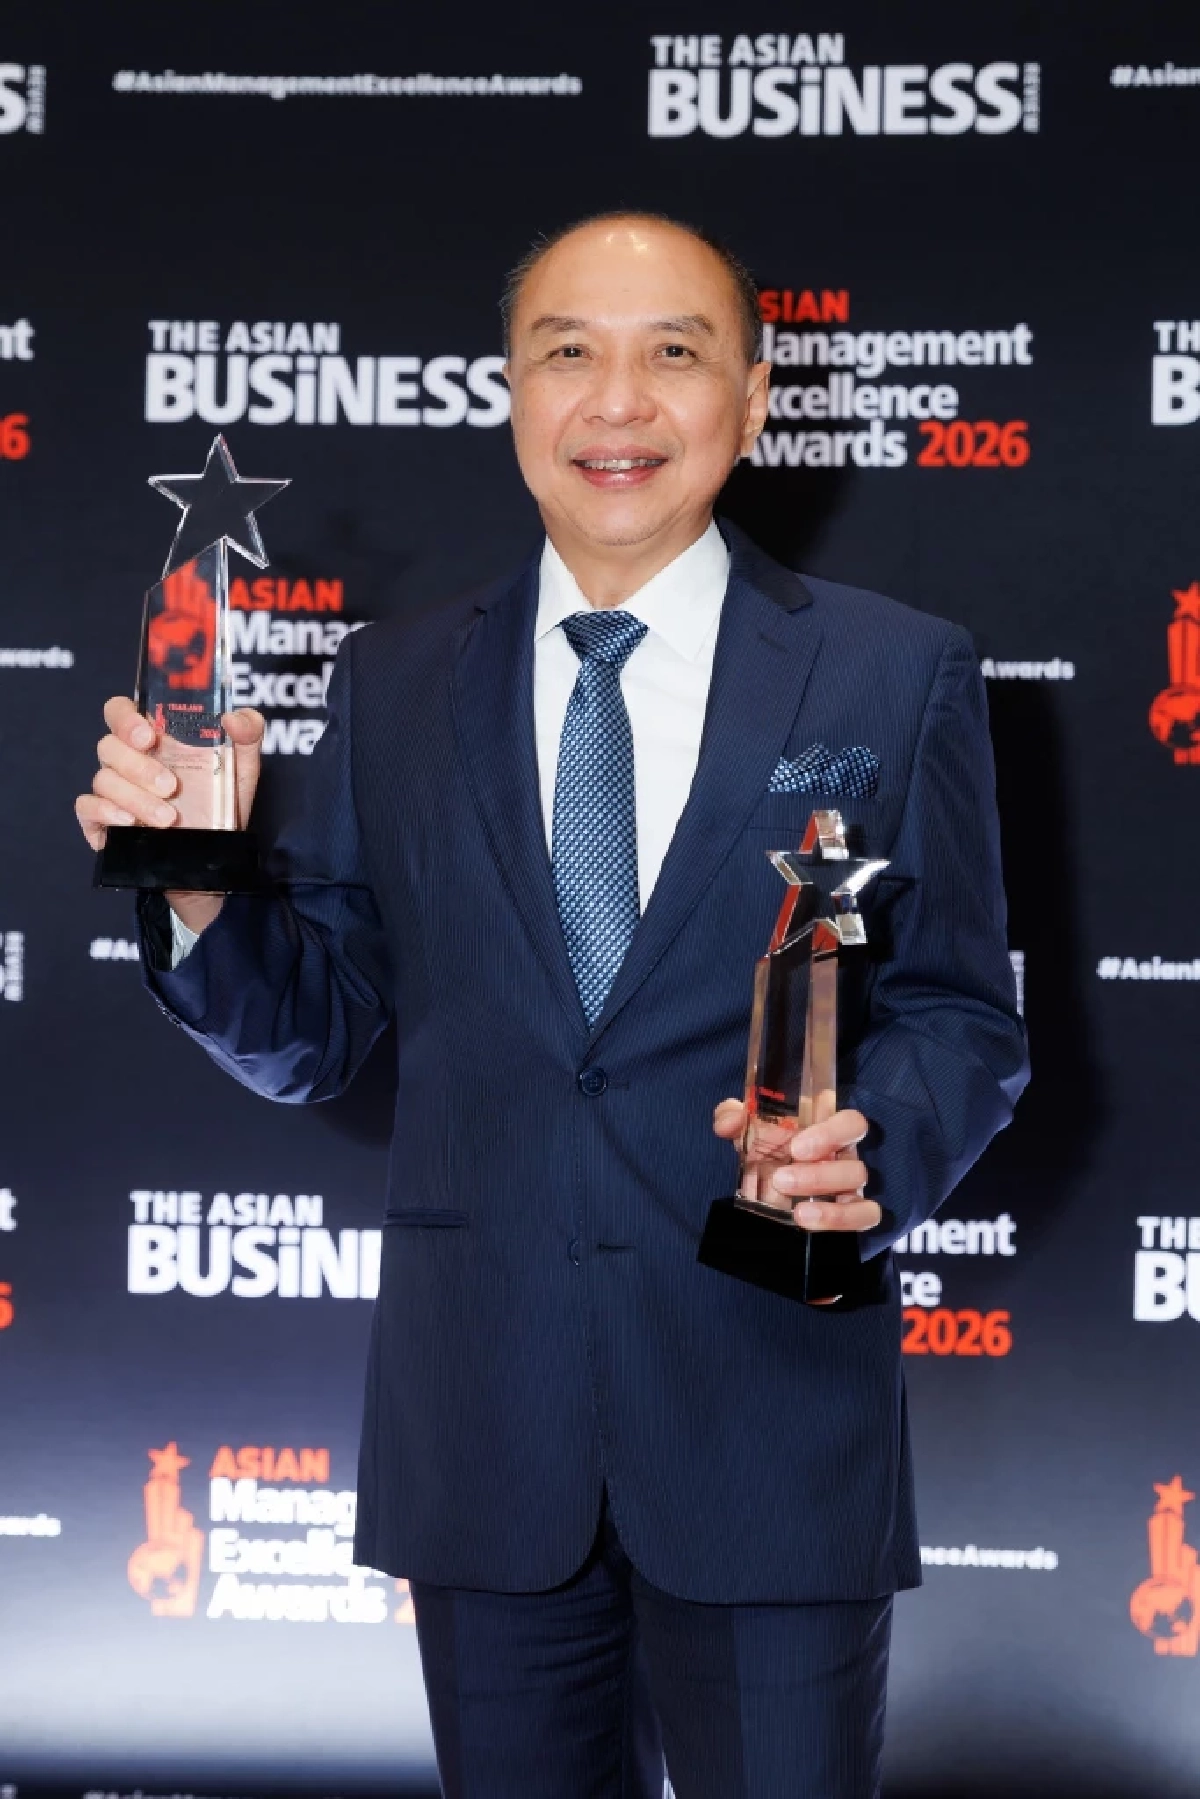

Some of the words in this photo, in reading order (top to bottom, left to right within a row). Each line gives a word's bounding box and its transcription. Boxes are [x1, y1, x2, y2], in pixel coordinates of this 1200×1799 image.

[650, 34, 722, 67] THE
[728, 32, 845, 66] ASIAN
[112, 69, 583, 100] #AsianManagementExcellenceAwards
[148, 320, 221, 351] THE
[225, 321, 341, 353] ASIAN
[917, 420, 1030, 468] 2026
[229, 576, 344, 612] ASIAN
[228, 610, 375, 656] Mana
[130, 1190, 202, 1224] THE
[207, 1193, 324, 1227] ASIAN
[901, 1307, 1013, 1357] 2026
[209, 1445, 331, 1484] ASIAN
[206, 1570, 388, 1624] Awards
